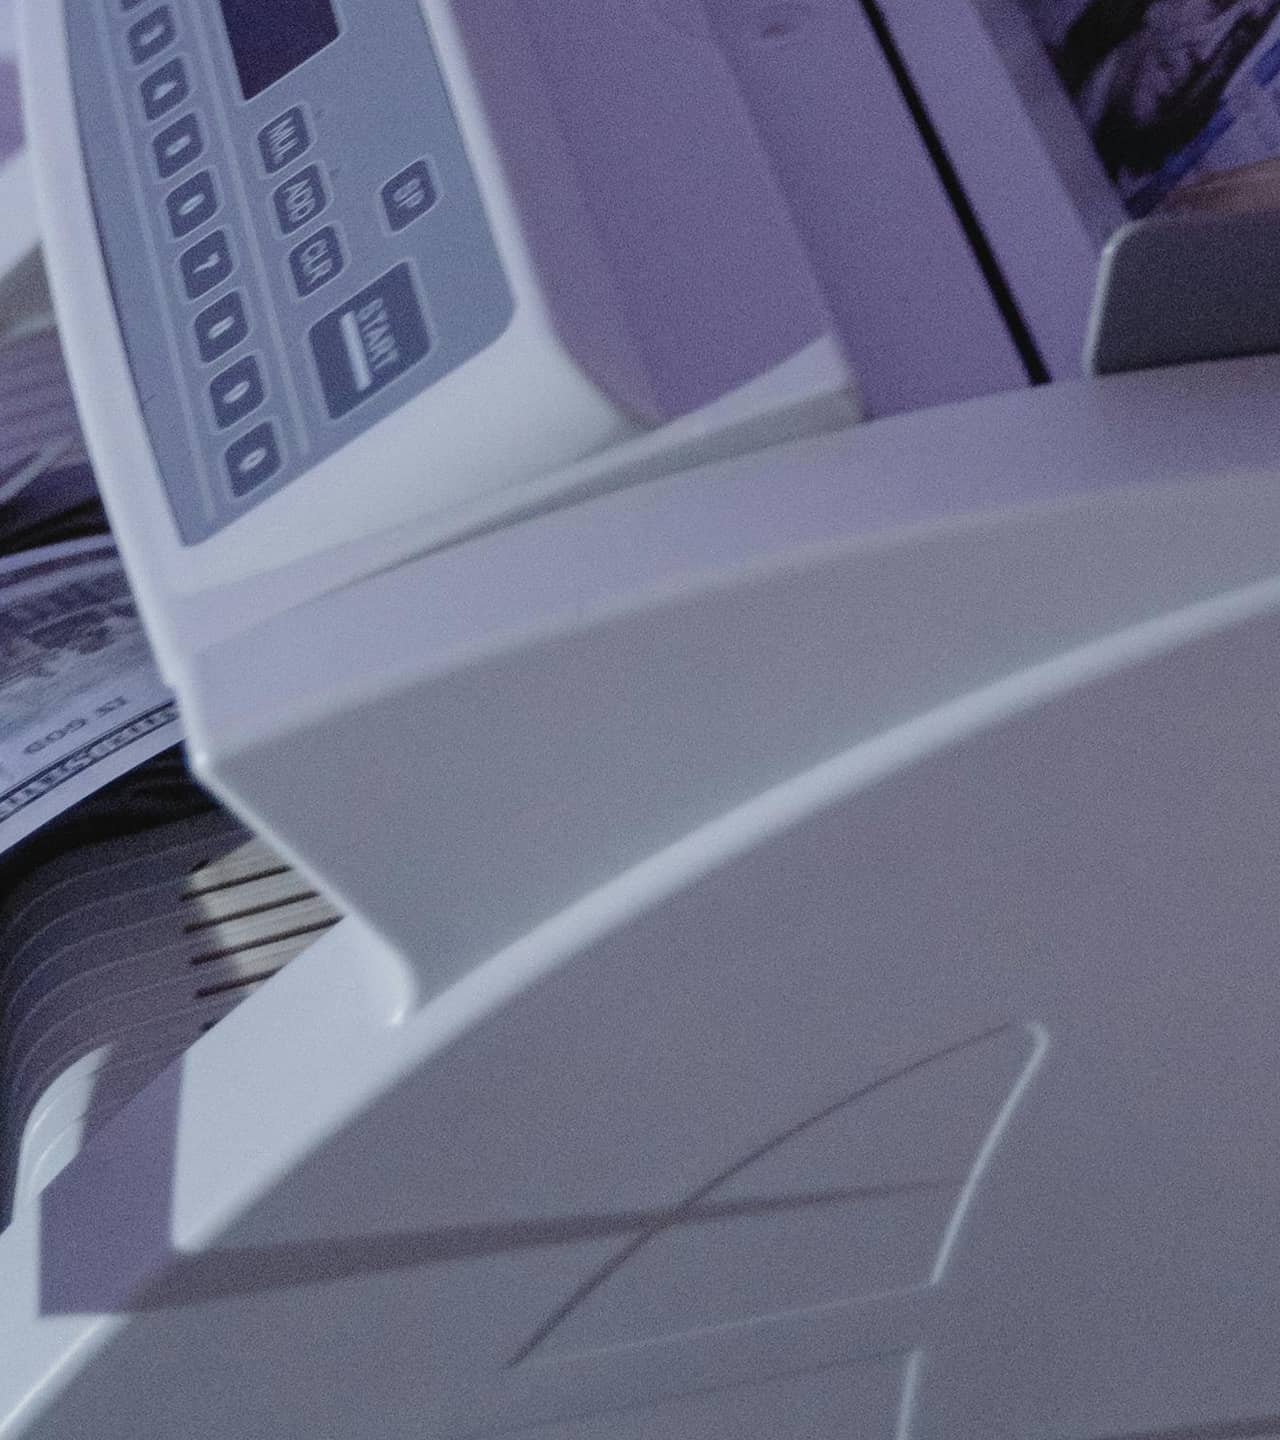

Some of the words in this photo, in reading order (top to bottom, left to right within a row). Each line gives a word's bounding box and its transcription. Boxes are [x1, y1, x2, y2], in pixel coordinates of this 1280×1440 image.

[266, 116, 301, 163] MUL
[281, 176, 316, 224] ADD
[390, 176, 424, 213] SP
[297, 237, 332, 285] CLR
[355, 298, 397, 374] START
[93, 692, 128, 719] IN
[20, 712, 88, 759] GOD
